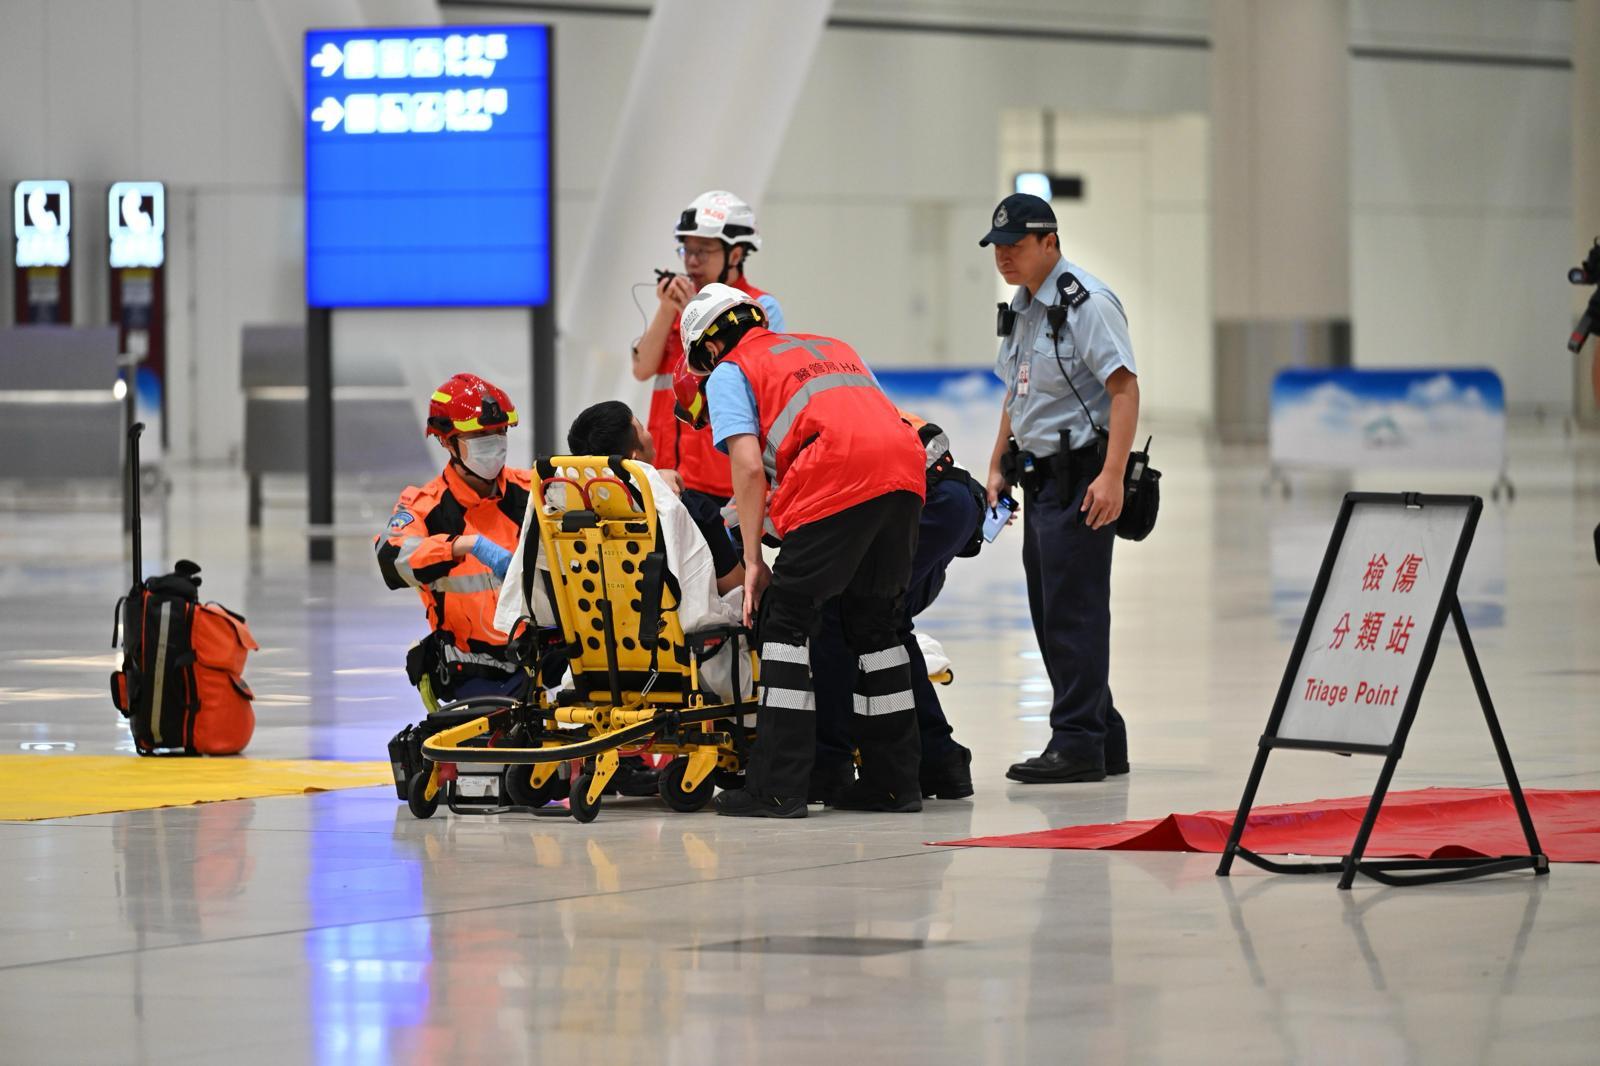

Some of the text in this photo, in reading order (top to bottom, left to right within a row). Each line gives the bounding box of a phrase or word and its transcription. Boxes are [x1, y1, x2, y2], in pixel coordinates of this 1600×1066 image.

[839, 362, 861, 373] HA
[1362, 553, 1423, 592] 檢傷
[1329, 611, 1415, 654] 分類站
[1304, 678, 1399, 706] Triage Point
